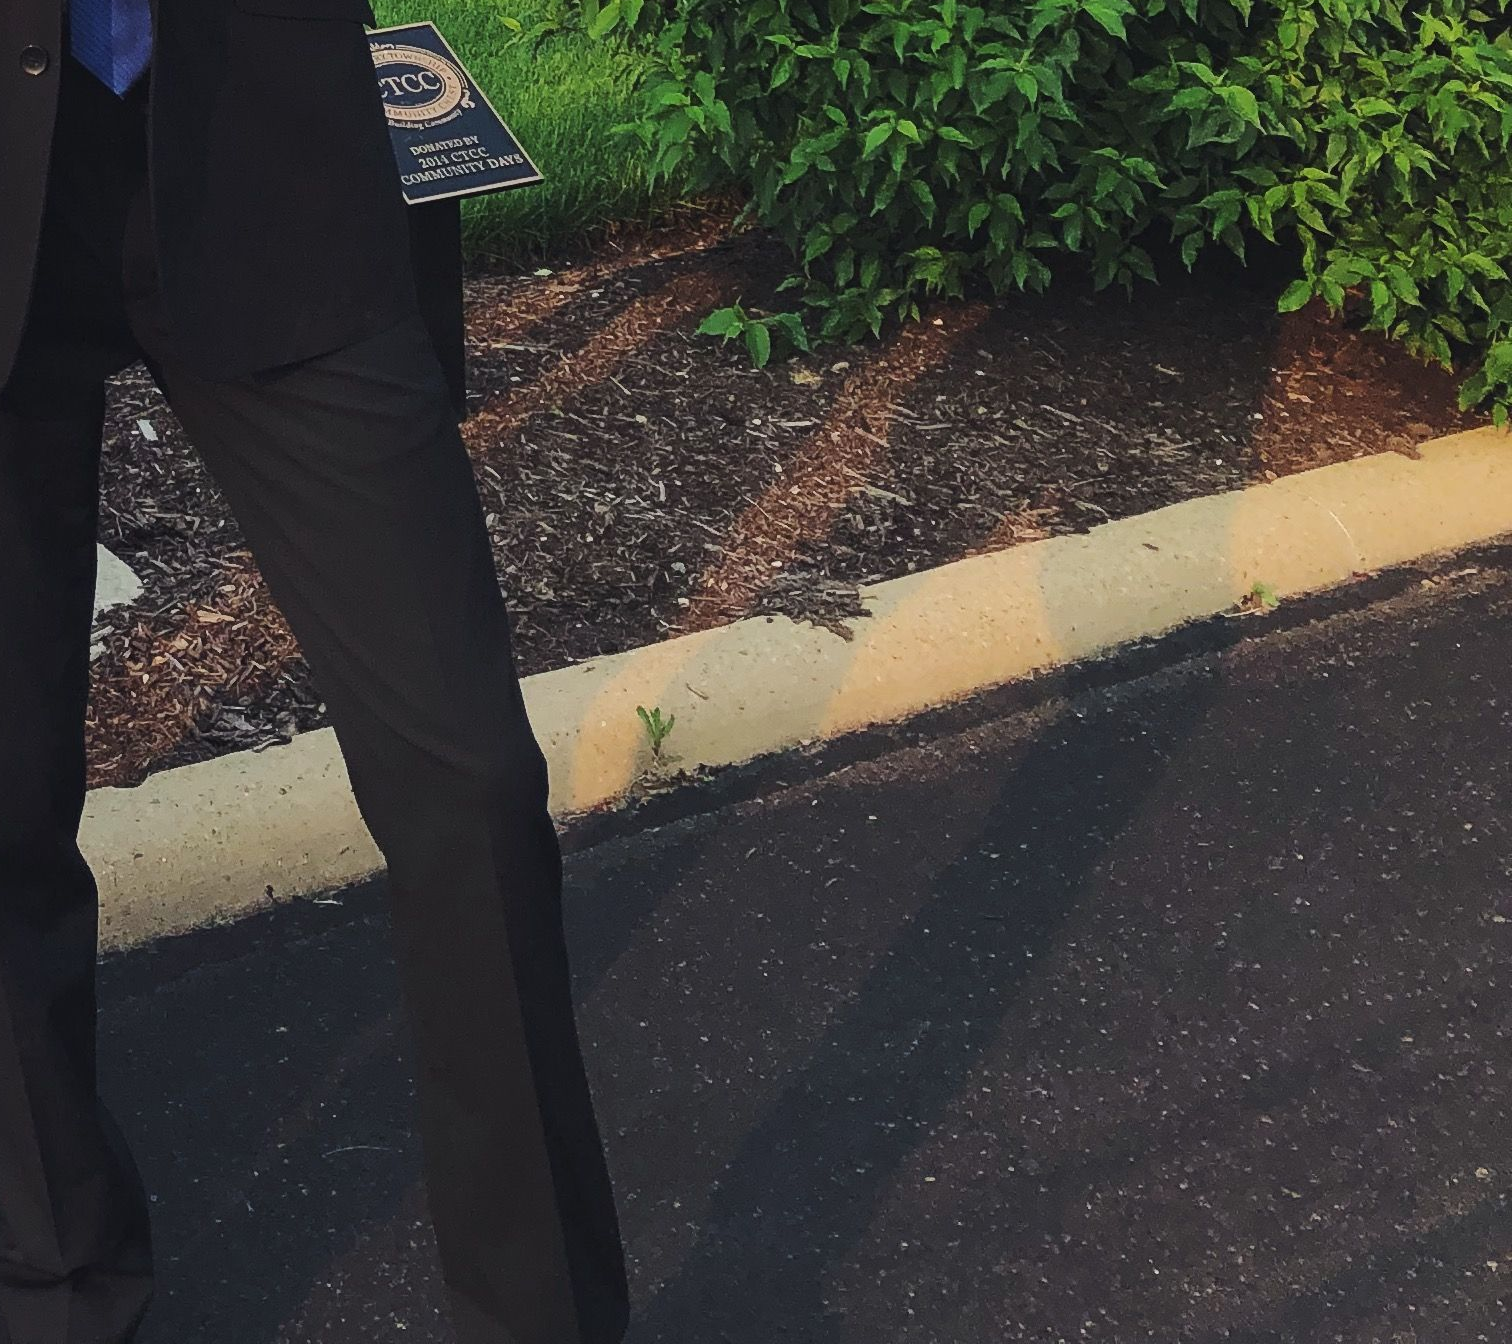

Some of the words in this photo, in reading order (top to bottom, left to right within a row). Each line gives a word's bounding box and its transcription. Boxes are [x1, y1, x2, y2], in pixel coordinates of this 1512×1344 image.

[409, 138, 463, 156] DONATED
[463, 135, 479, 146] BY
[418, 155, 449, 169] 2014
[450, 147, 490, 162] CTCC
[400, 160, 486, 186] COMMUNITY
[487, 153, 524, 169] DAYS
